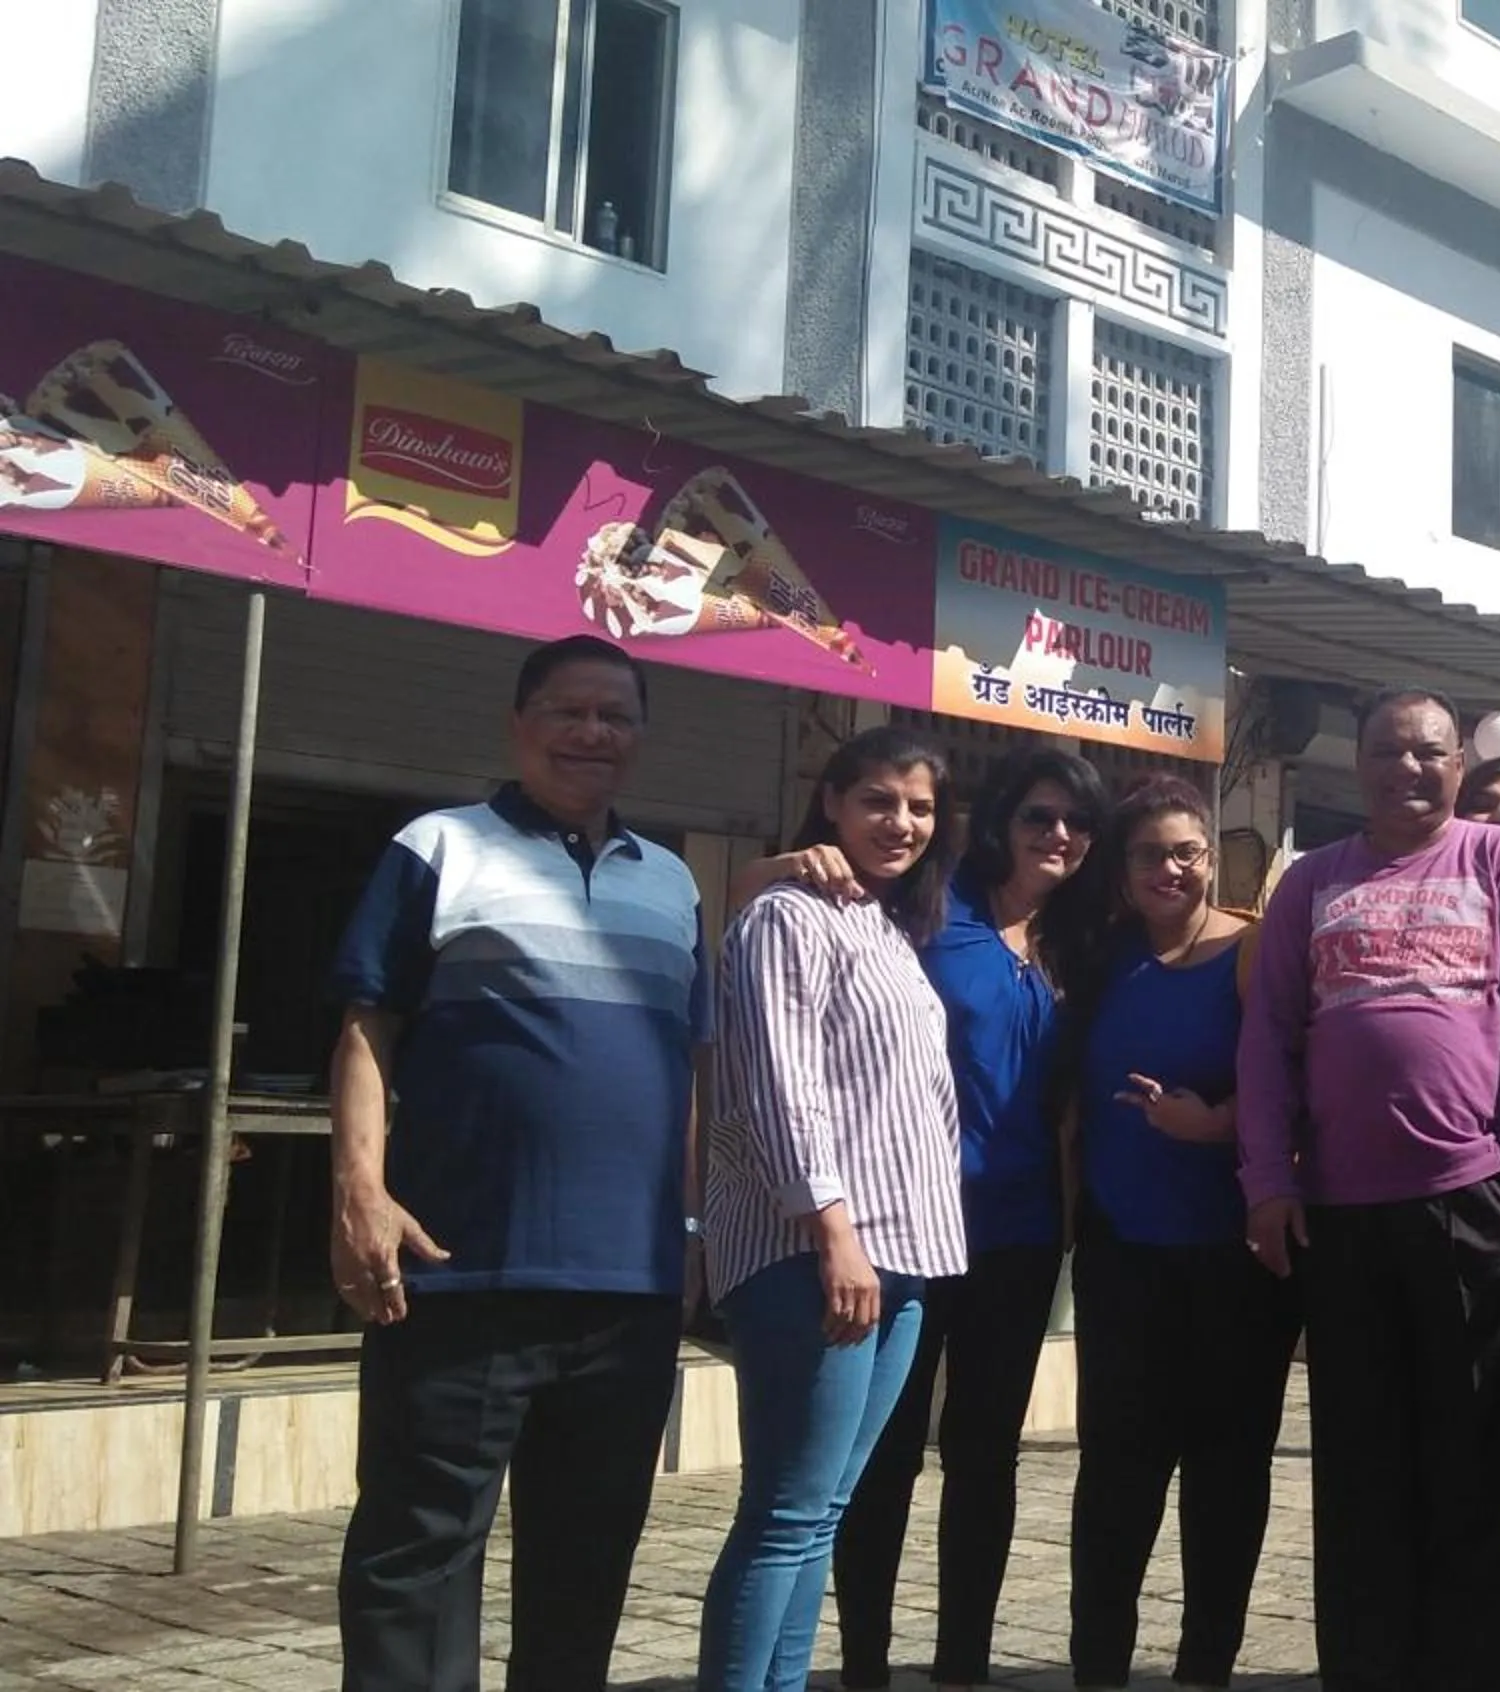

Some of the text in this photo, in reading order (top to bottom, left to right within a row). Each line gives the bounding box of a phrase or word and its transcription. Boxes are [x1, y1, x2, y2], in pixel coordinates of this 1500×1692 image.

[943, 23, 1113, 127] GRAND
[1006, 14, 1105, 79] HOTEL
[368, 416, 509, 476] Dinshaw's
[958, 540, 1212, 636] GRAND ICE-CREAM
[1024, 612, 1153, 677] PARLOUR
[1142, 703, 1196, 741] पार्लर
[1326, 886, 1459, 920] CHAMPIONS
[1362, 907, 1424, 927] TEAM
